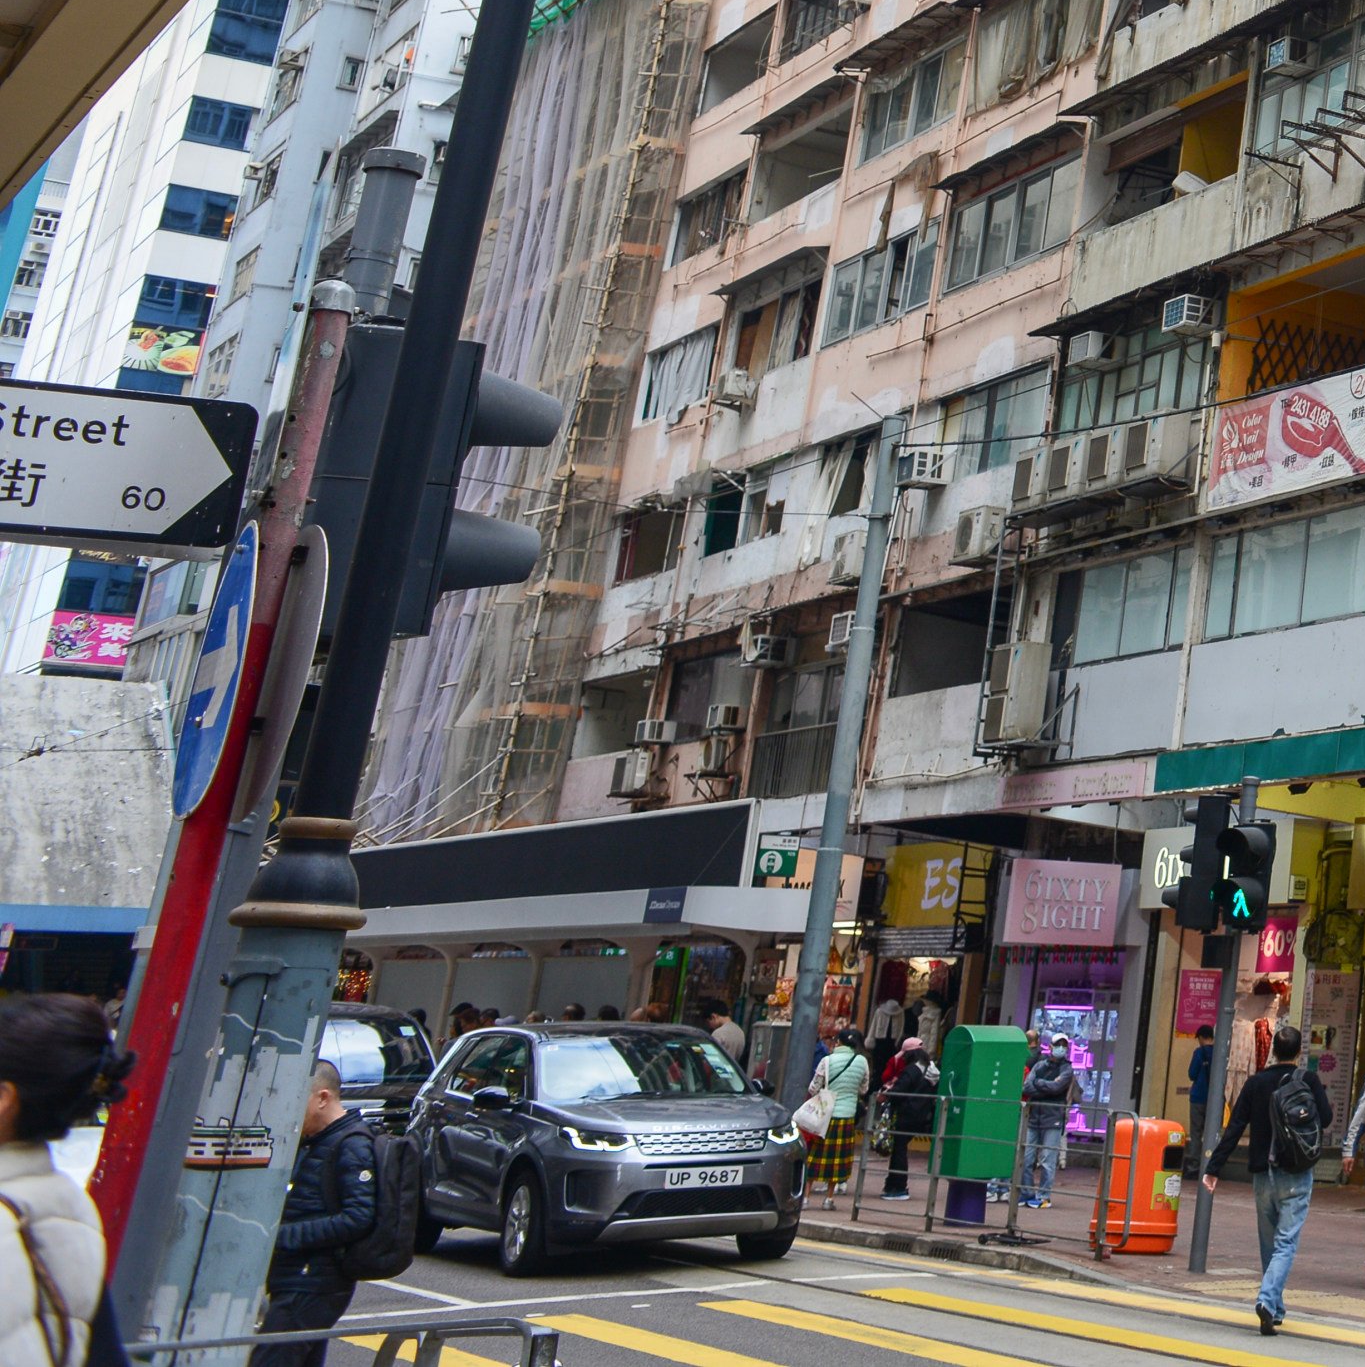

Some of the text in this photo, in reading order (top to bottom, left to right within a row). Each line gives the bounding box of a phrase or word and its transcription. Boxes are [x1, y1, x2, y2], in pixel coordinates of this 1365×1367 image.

[1242, 413, 1263, 429] Color
[1310, 408, 1331, 428] 4188
[1240, 431, 1258, 447] Nail
[1236, 447, 1265, 465] Design
[121, 485, 166, 511] 60
[1025, 869, 1111, 902] 6IXTY
[1021, 902, 1105, 934] 8IGHT
[652, 1121, 752, 1133] DISCOVERY
[669, 1169, 741, 1186] UP 9687
